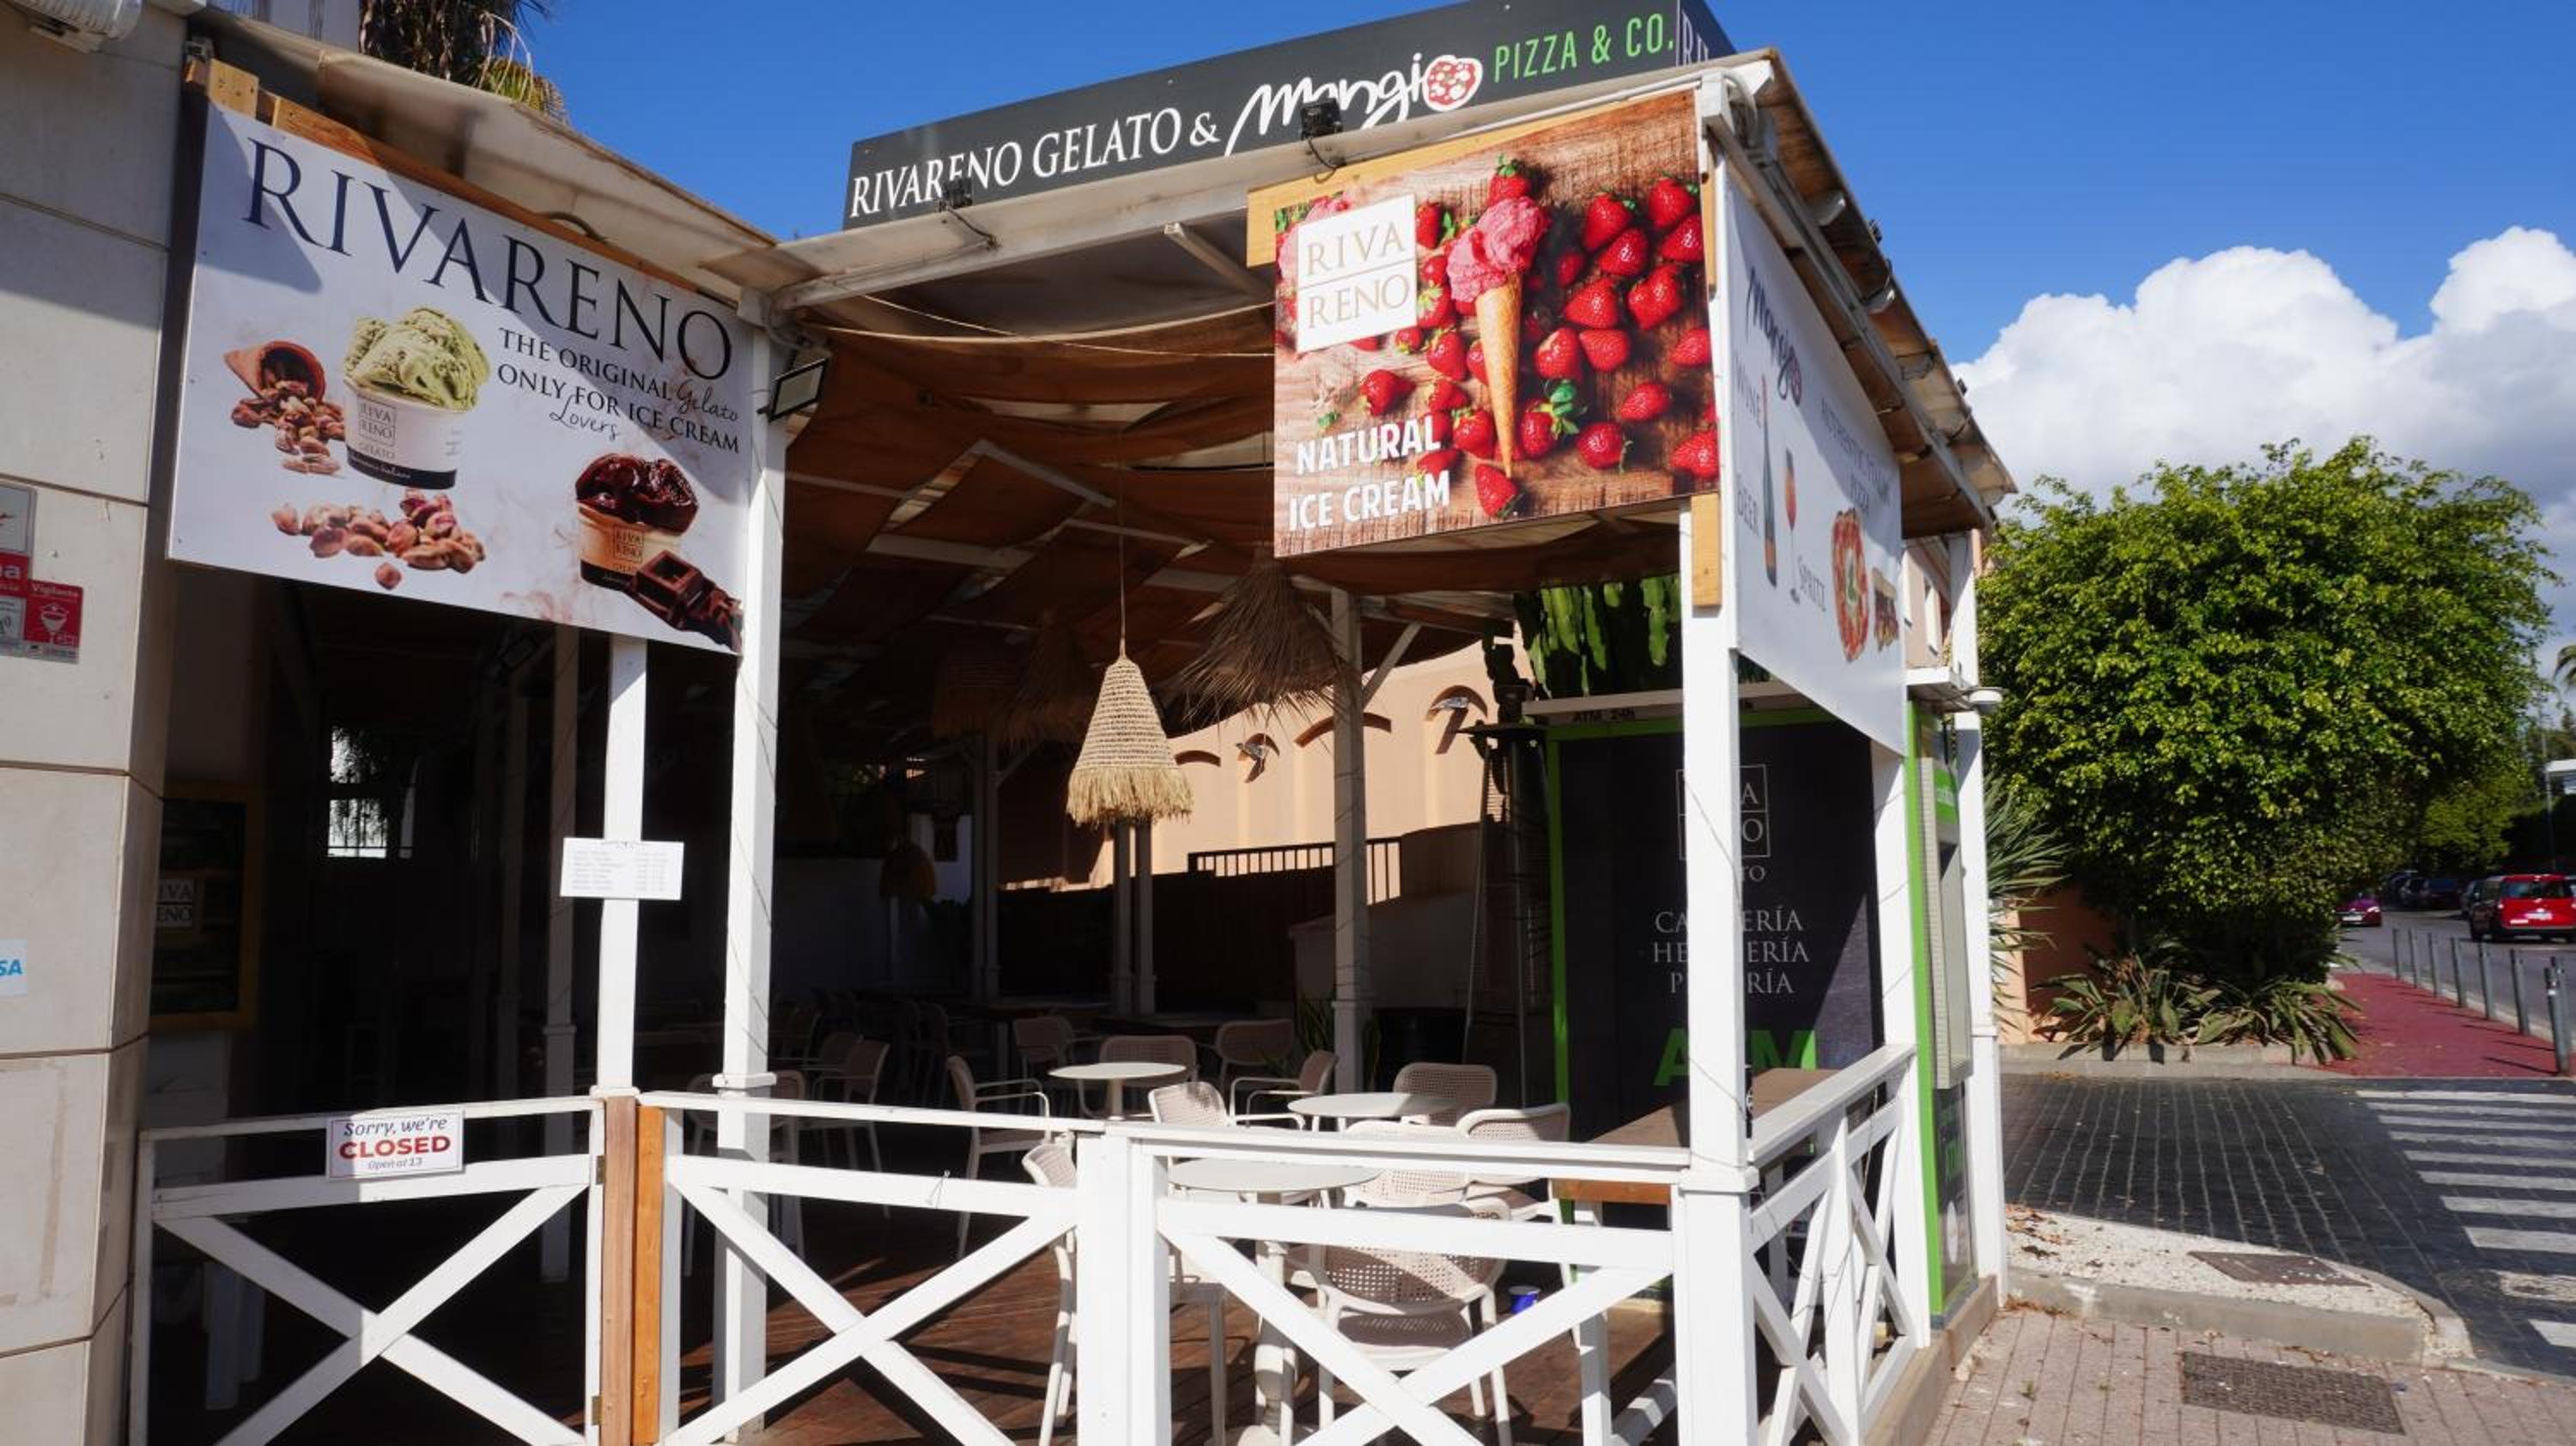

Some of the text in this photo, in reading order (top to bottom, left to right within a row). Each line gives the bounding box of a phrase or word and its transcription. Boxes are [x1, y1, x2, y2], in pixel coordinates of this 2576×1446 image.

[849, 142, 1022, 218] RIVARENO
[1032, 107, 1182, 178] GELATO
[1190, 112, 1220, 148] &
[1494, 31, 1577, 82] PIZZA
[1591, 24, 1611, 64] &
[1625, 13, 1674, 58] CO.
[242, 137, 733, 380] RIVARENO
[1306, 221, 1406, 276] RIVA
[1308, 274, 1410, 328] RENO
[499, 327, 550, 362] THE
[559, 349, 671, 401] ORIGINAL
[498, 363, 739, 453] ONLY FOR ICE CREAM
[550, 394, 620, 441] Lovers
[1297, 415, 1441, 475] NATURAL
[1290, 471, 1450, 531] ICE CREAM
[1655, 905, 1803, 933] CAERÍA
[1654, 936, 1809, 963] HEERÍA
[1671, 968, 1795, 993] PRÍA
[1653, 1028, 1817, 1086] AM
[339, 1135, 451, 1159] CLOSED
[343, 1117, 447, 1137] Sorry, we're
[368, 1159, 395, 1170] Open
